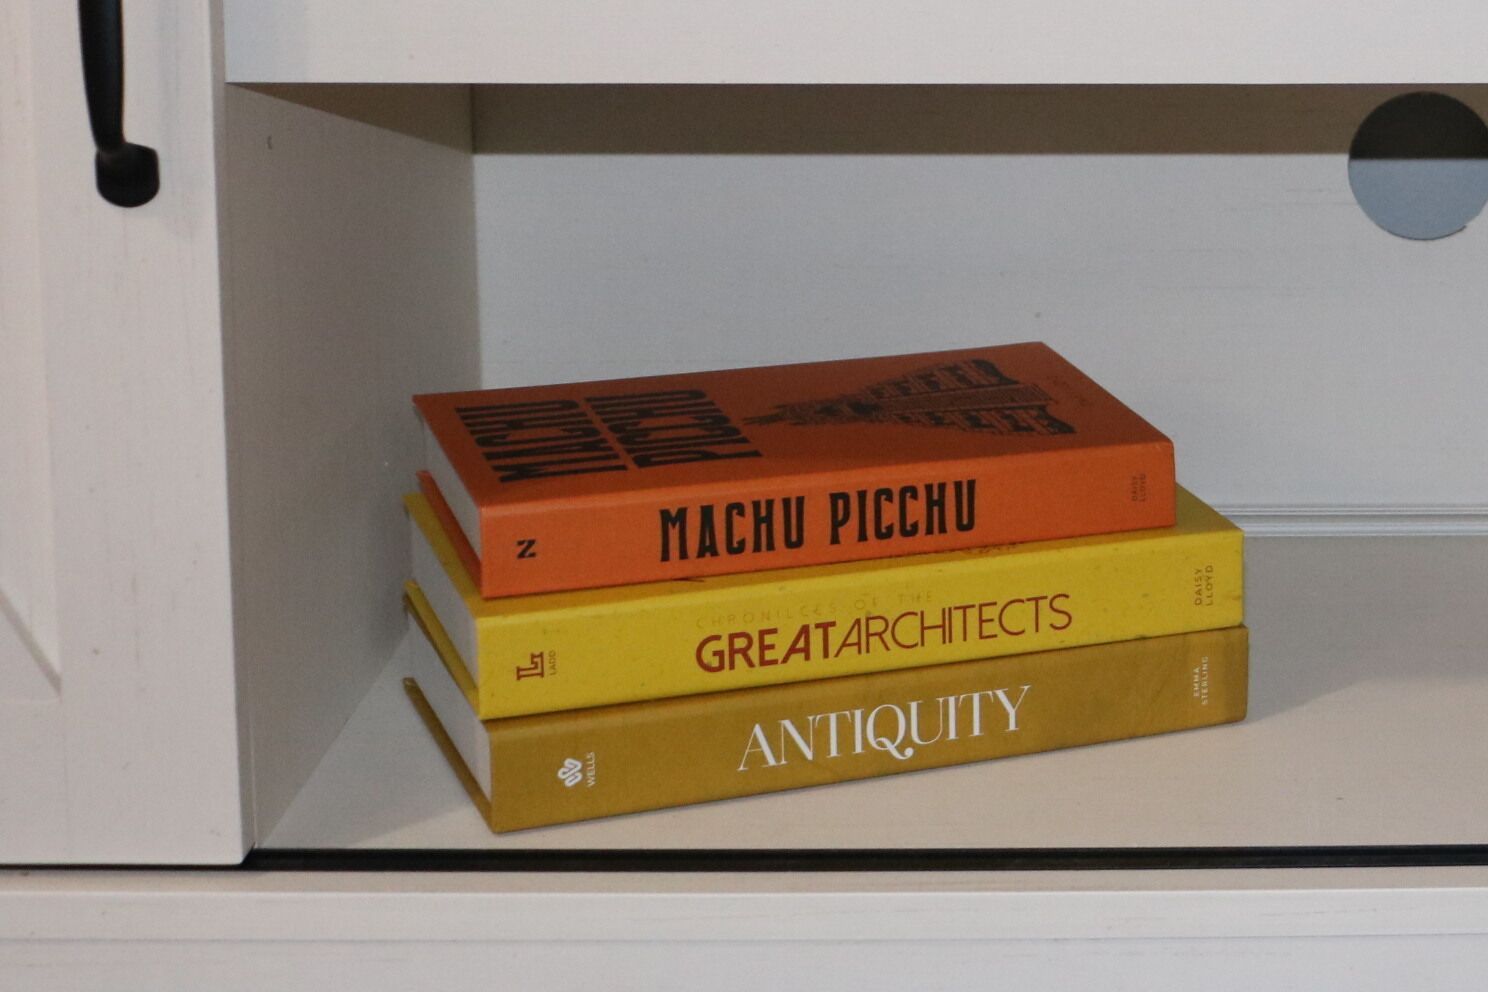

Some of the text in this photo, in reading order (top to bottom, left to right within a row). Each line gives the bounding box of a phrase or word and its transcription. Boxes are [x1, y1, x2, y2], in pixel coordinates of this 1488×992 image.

[659, 479, 976, 562] MACHU PICCHU
[1194, 568, 1202, 606] DAISY
[1204, 565, 1214, 606] LLOYD
[1200, 656, 1209, 705] STERLING
[736, 685, 1032, 771] ANTIQUITY
